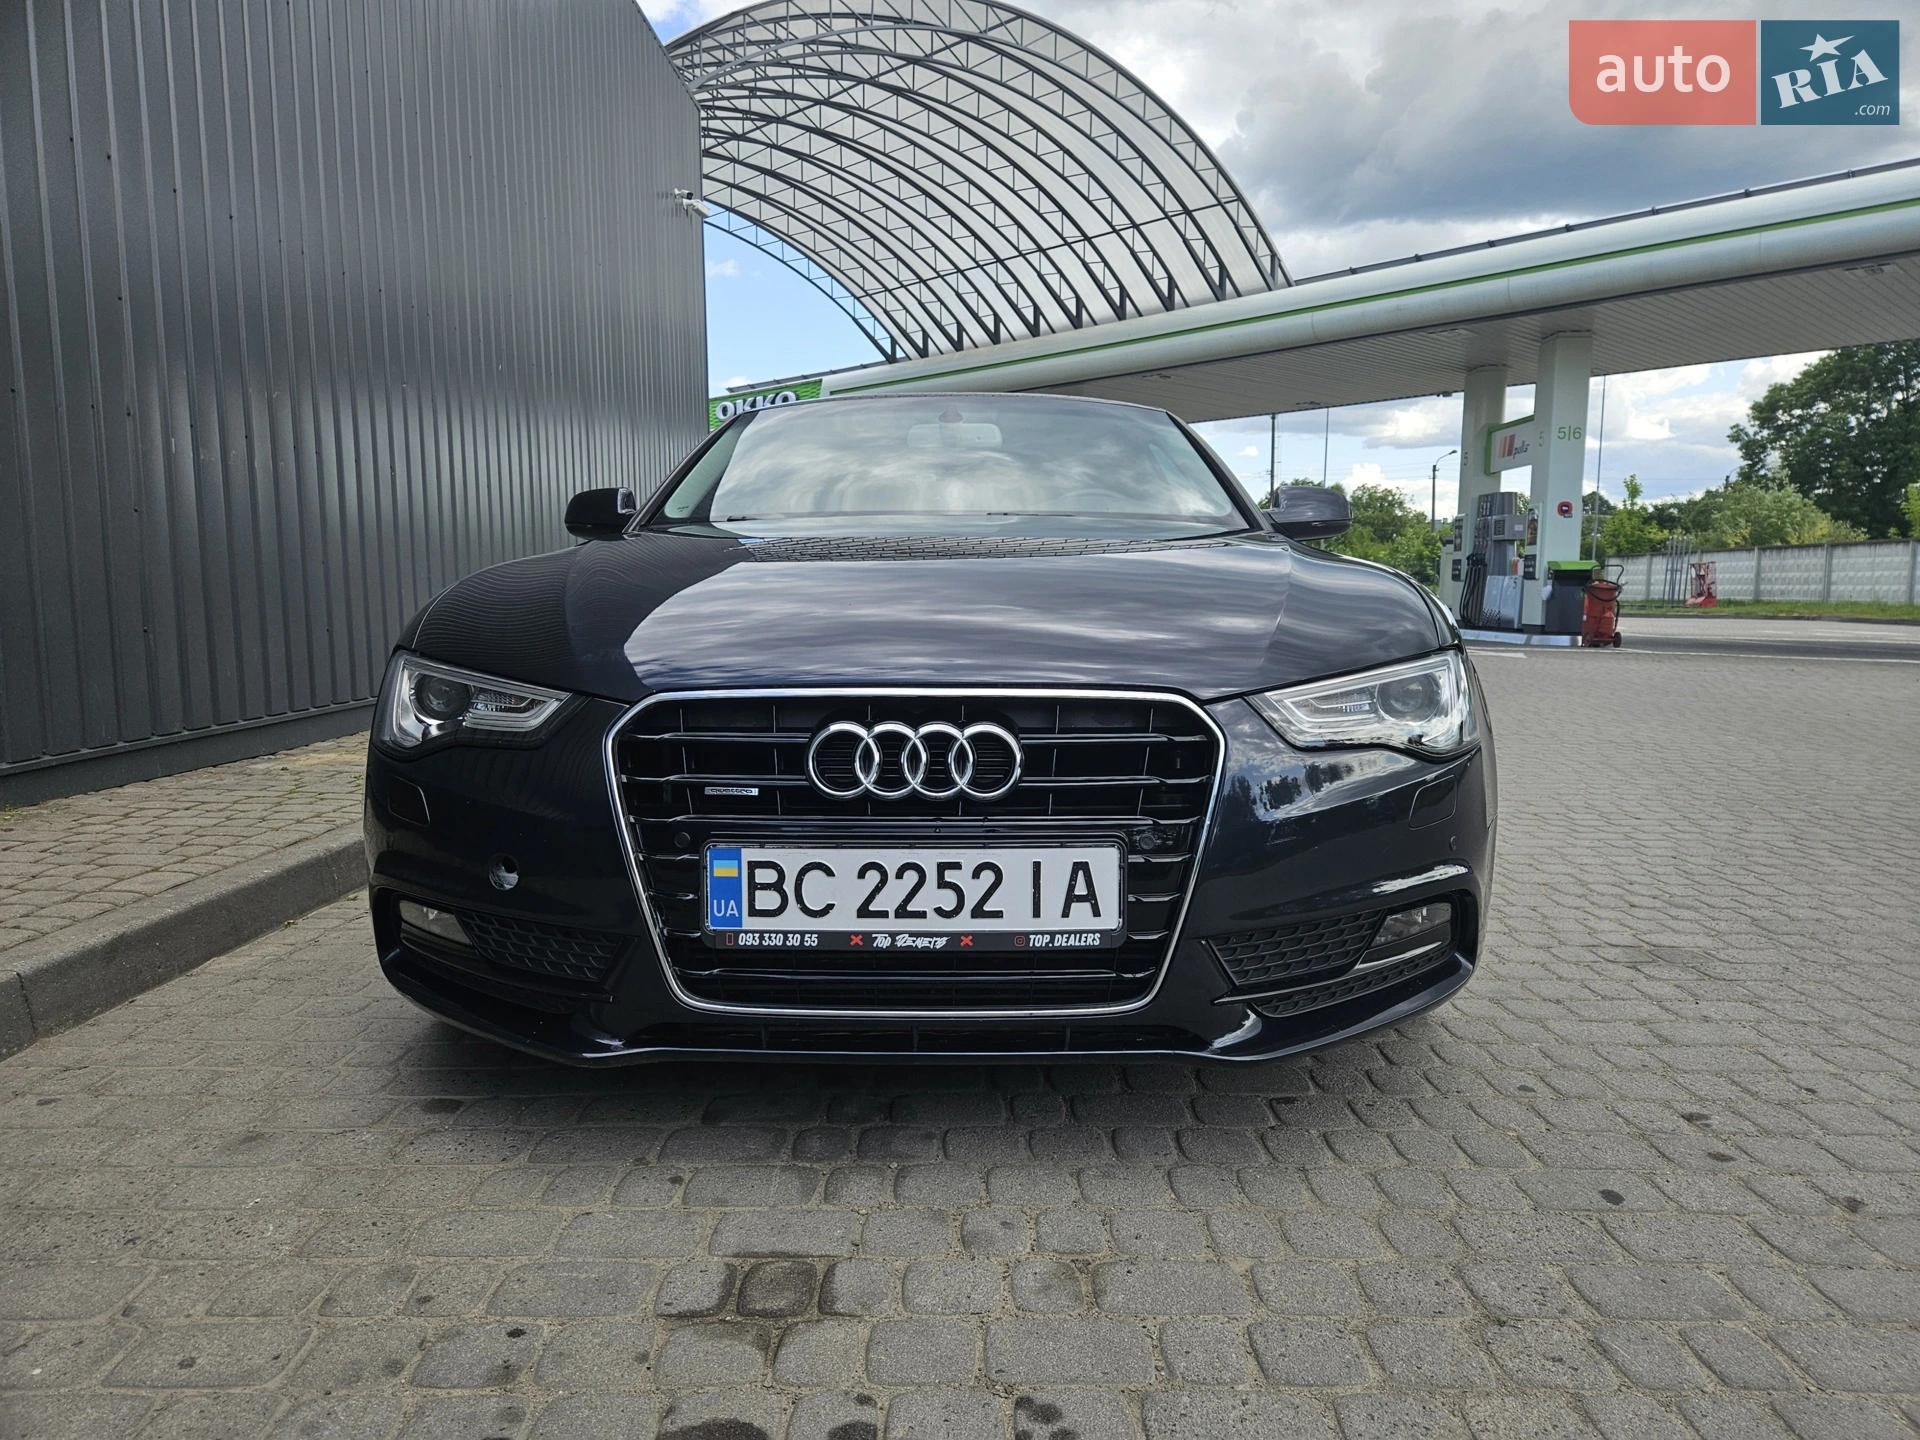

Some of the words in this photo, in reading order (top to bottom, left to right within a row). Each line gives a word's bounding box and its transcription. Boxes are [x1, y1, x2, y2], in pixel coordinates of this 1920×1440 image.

[715, 390, 797, 421] OKKO
[747, 860, 836, 919] BC
[856, 860, 1004, 919] 2252
[1031, 860, 1102, 919] IA
[713, 899, 740, 918] UA
[738, 932, 760, 946] 093
[762, 933, 784, 946] 330
[786, 933, 801, 947] 30
[804, 934, 818, 946] 55
